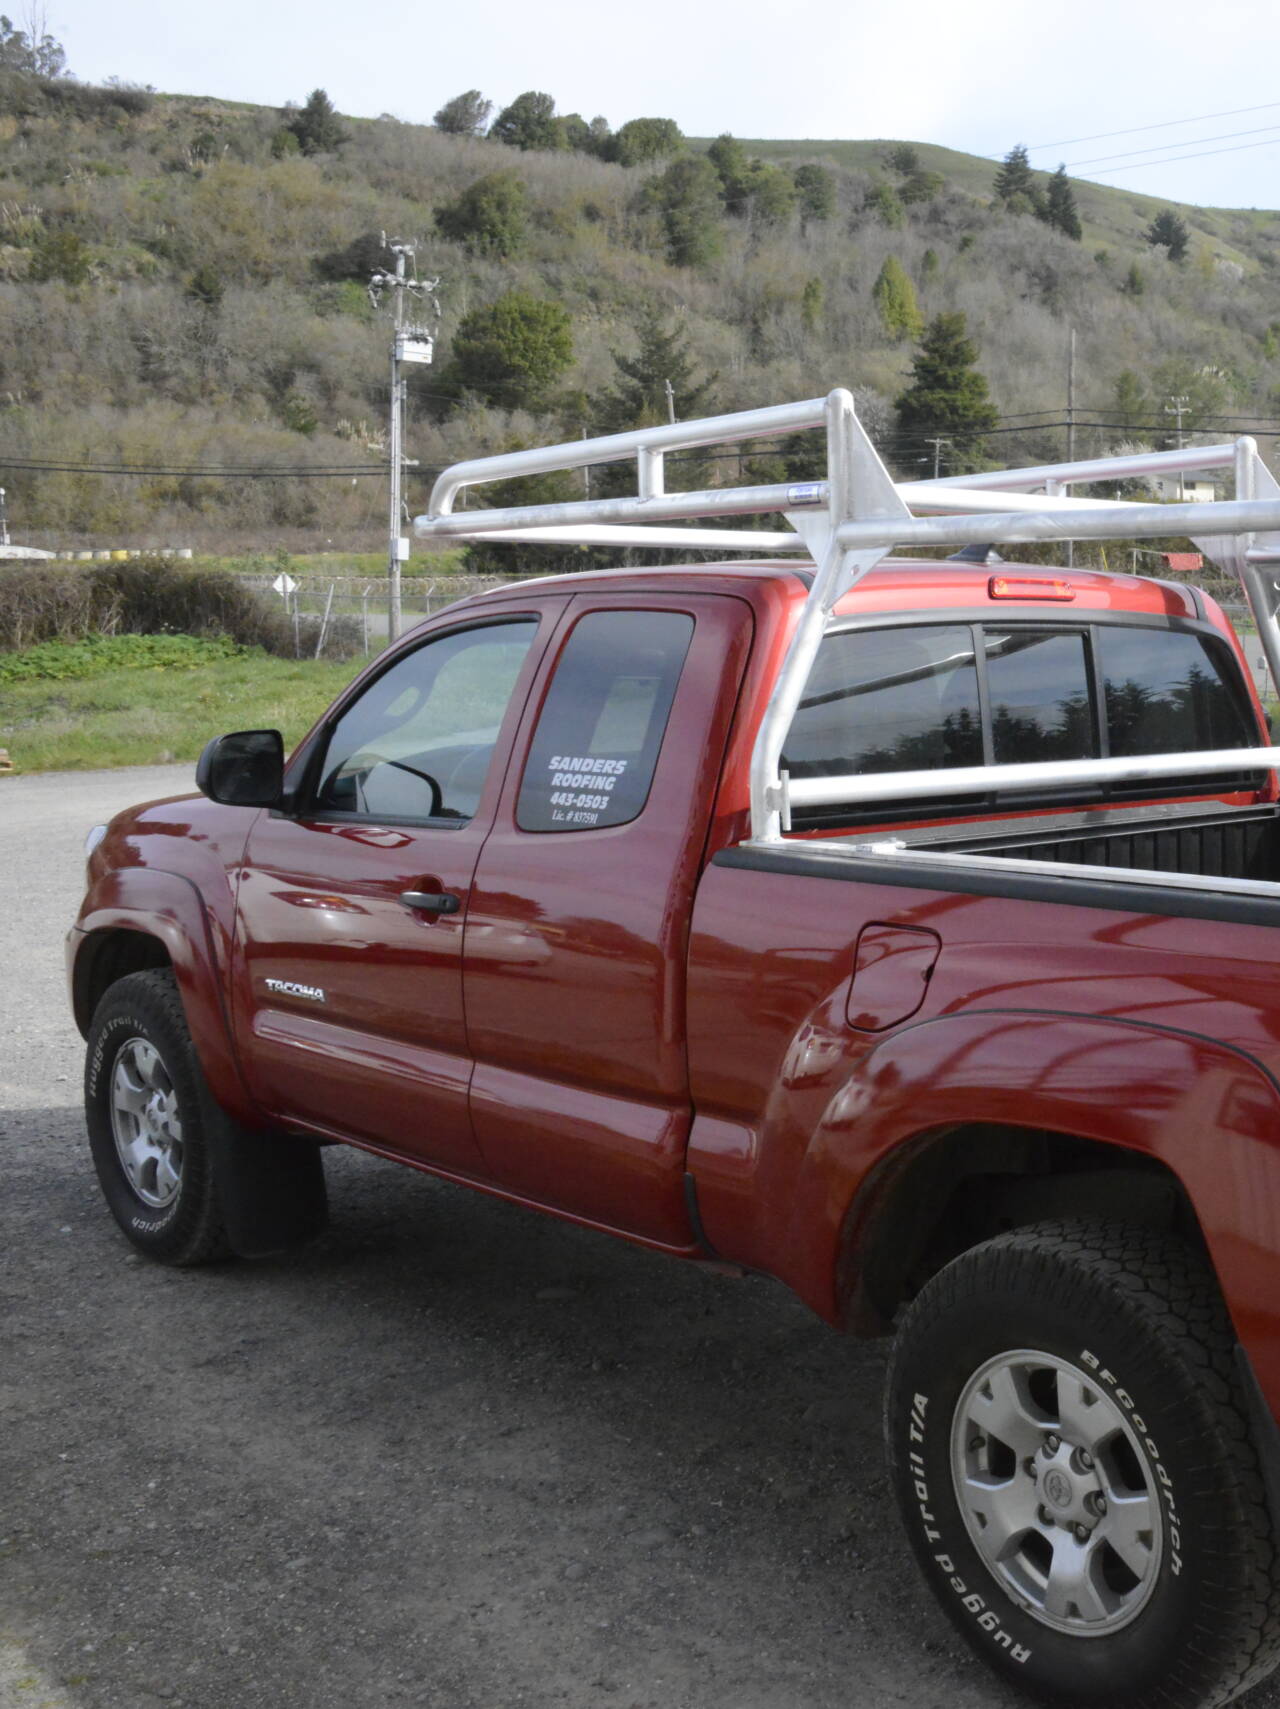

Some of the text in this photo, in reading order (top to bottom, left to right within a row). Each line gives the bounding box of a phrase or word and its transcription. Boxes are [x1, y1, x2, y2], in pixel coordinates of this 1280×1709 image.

[548, 756, 628, 774] SANDERS
[551, 773, 617, 790] ROOFING
[550, 792, 610, 809] 443-0503
[265, 978, 325, 1002] TACOMA
[909, 1393, 1033, 1664] Rugged Trail T/A
